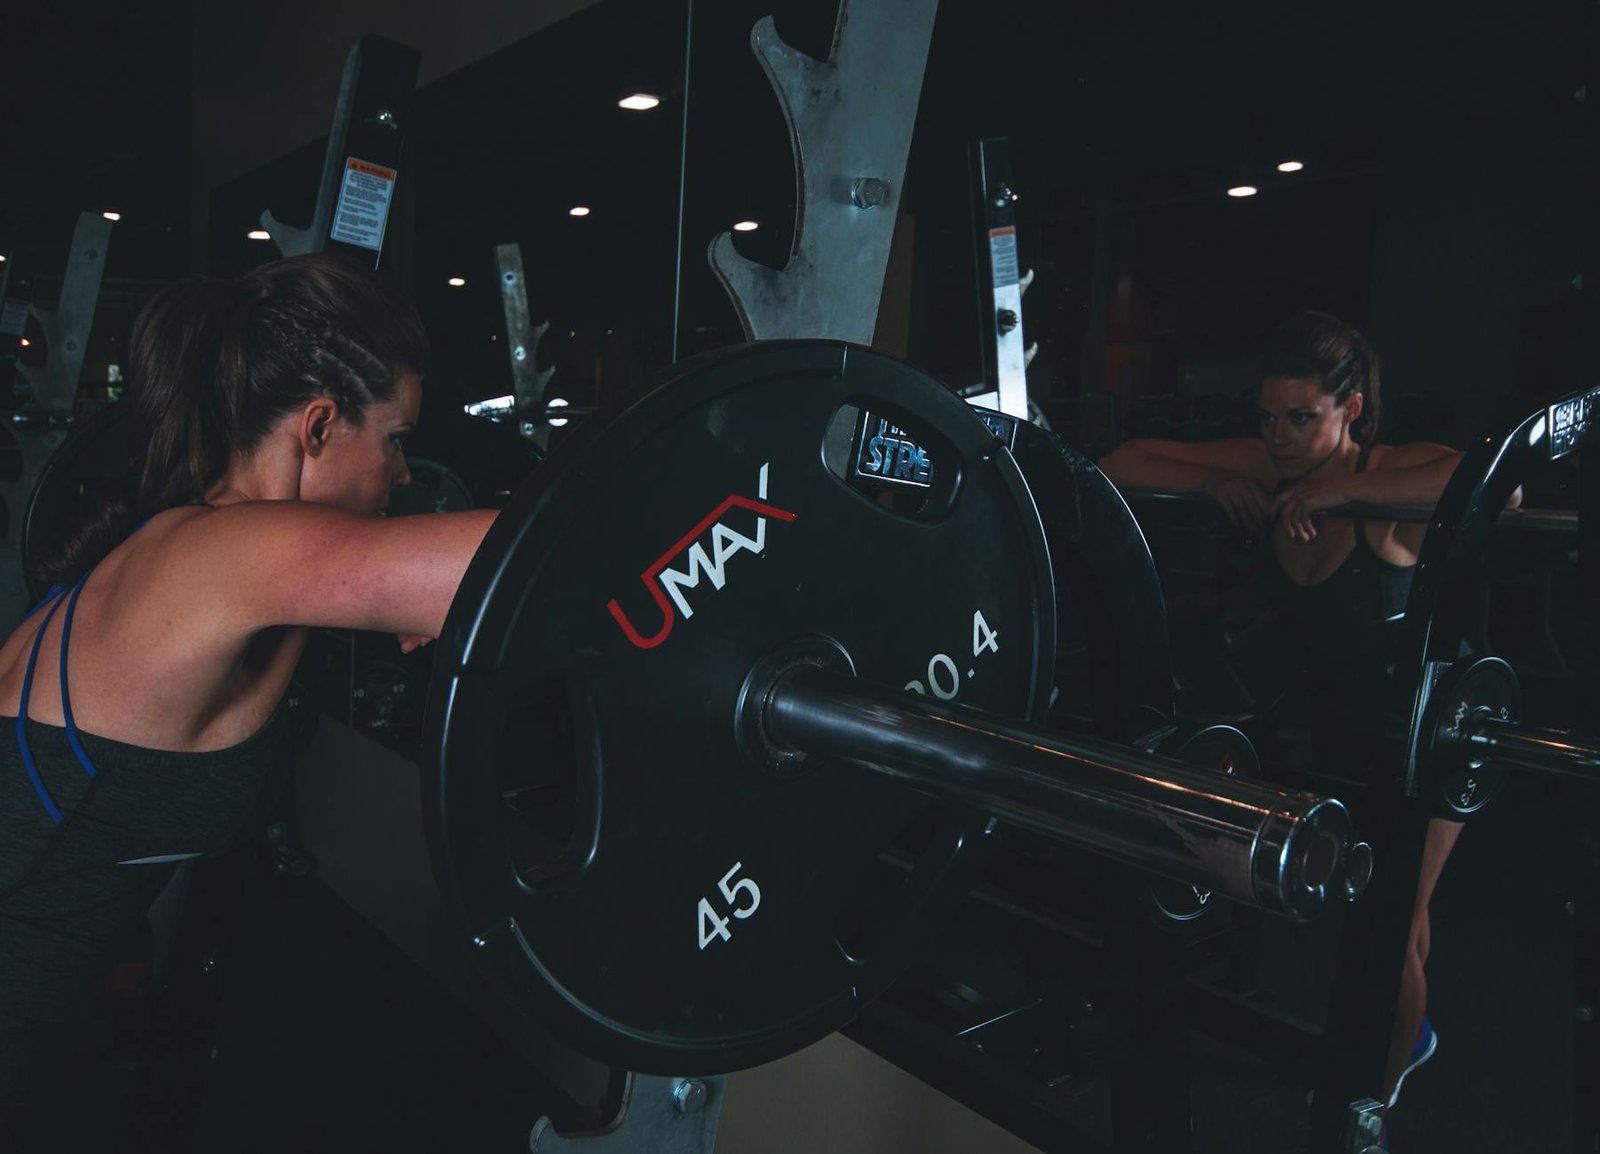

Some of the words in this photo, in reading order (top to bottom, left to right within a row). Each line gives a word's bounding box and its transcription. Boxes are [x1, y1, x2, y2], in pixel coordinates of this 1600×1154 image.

[606, 461, 797, 649] UMAX
[698, 861, 761, 951] 45
[1192, 885, 1211, 905] .3
